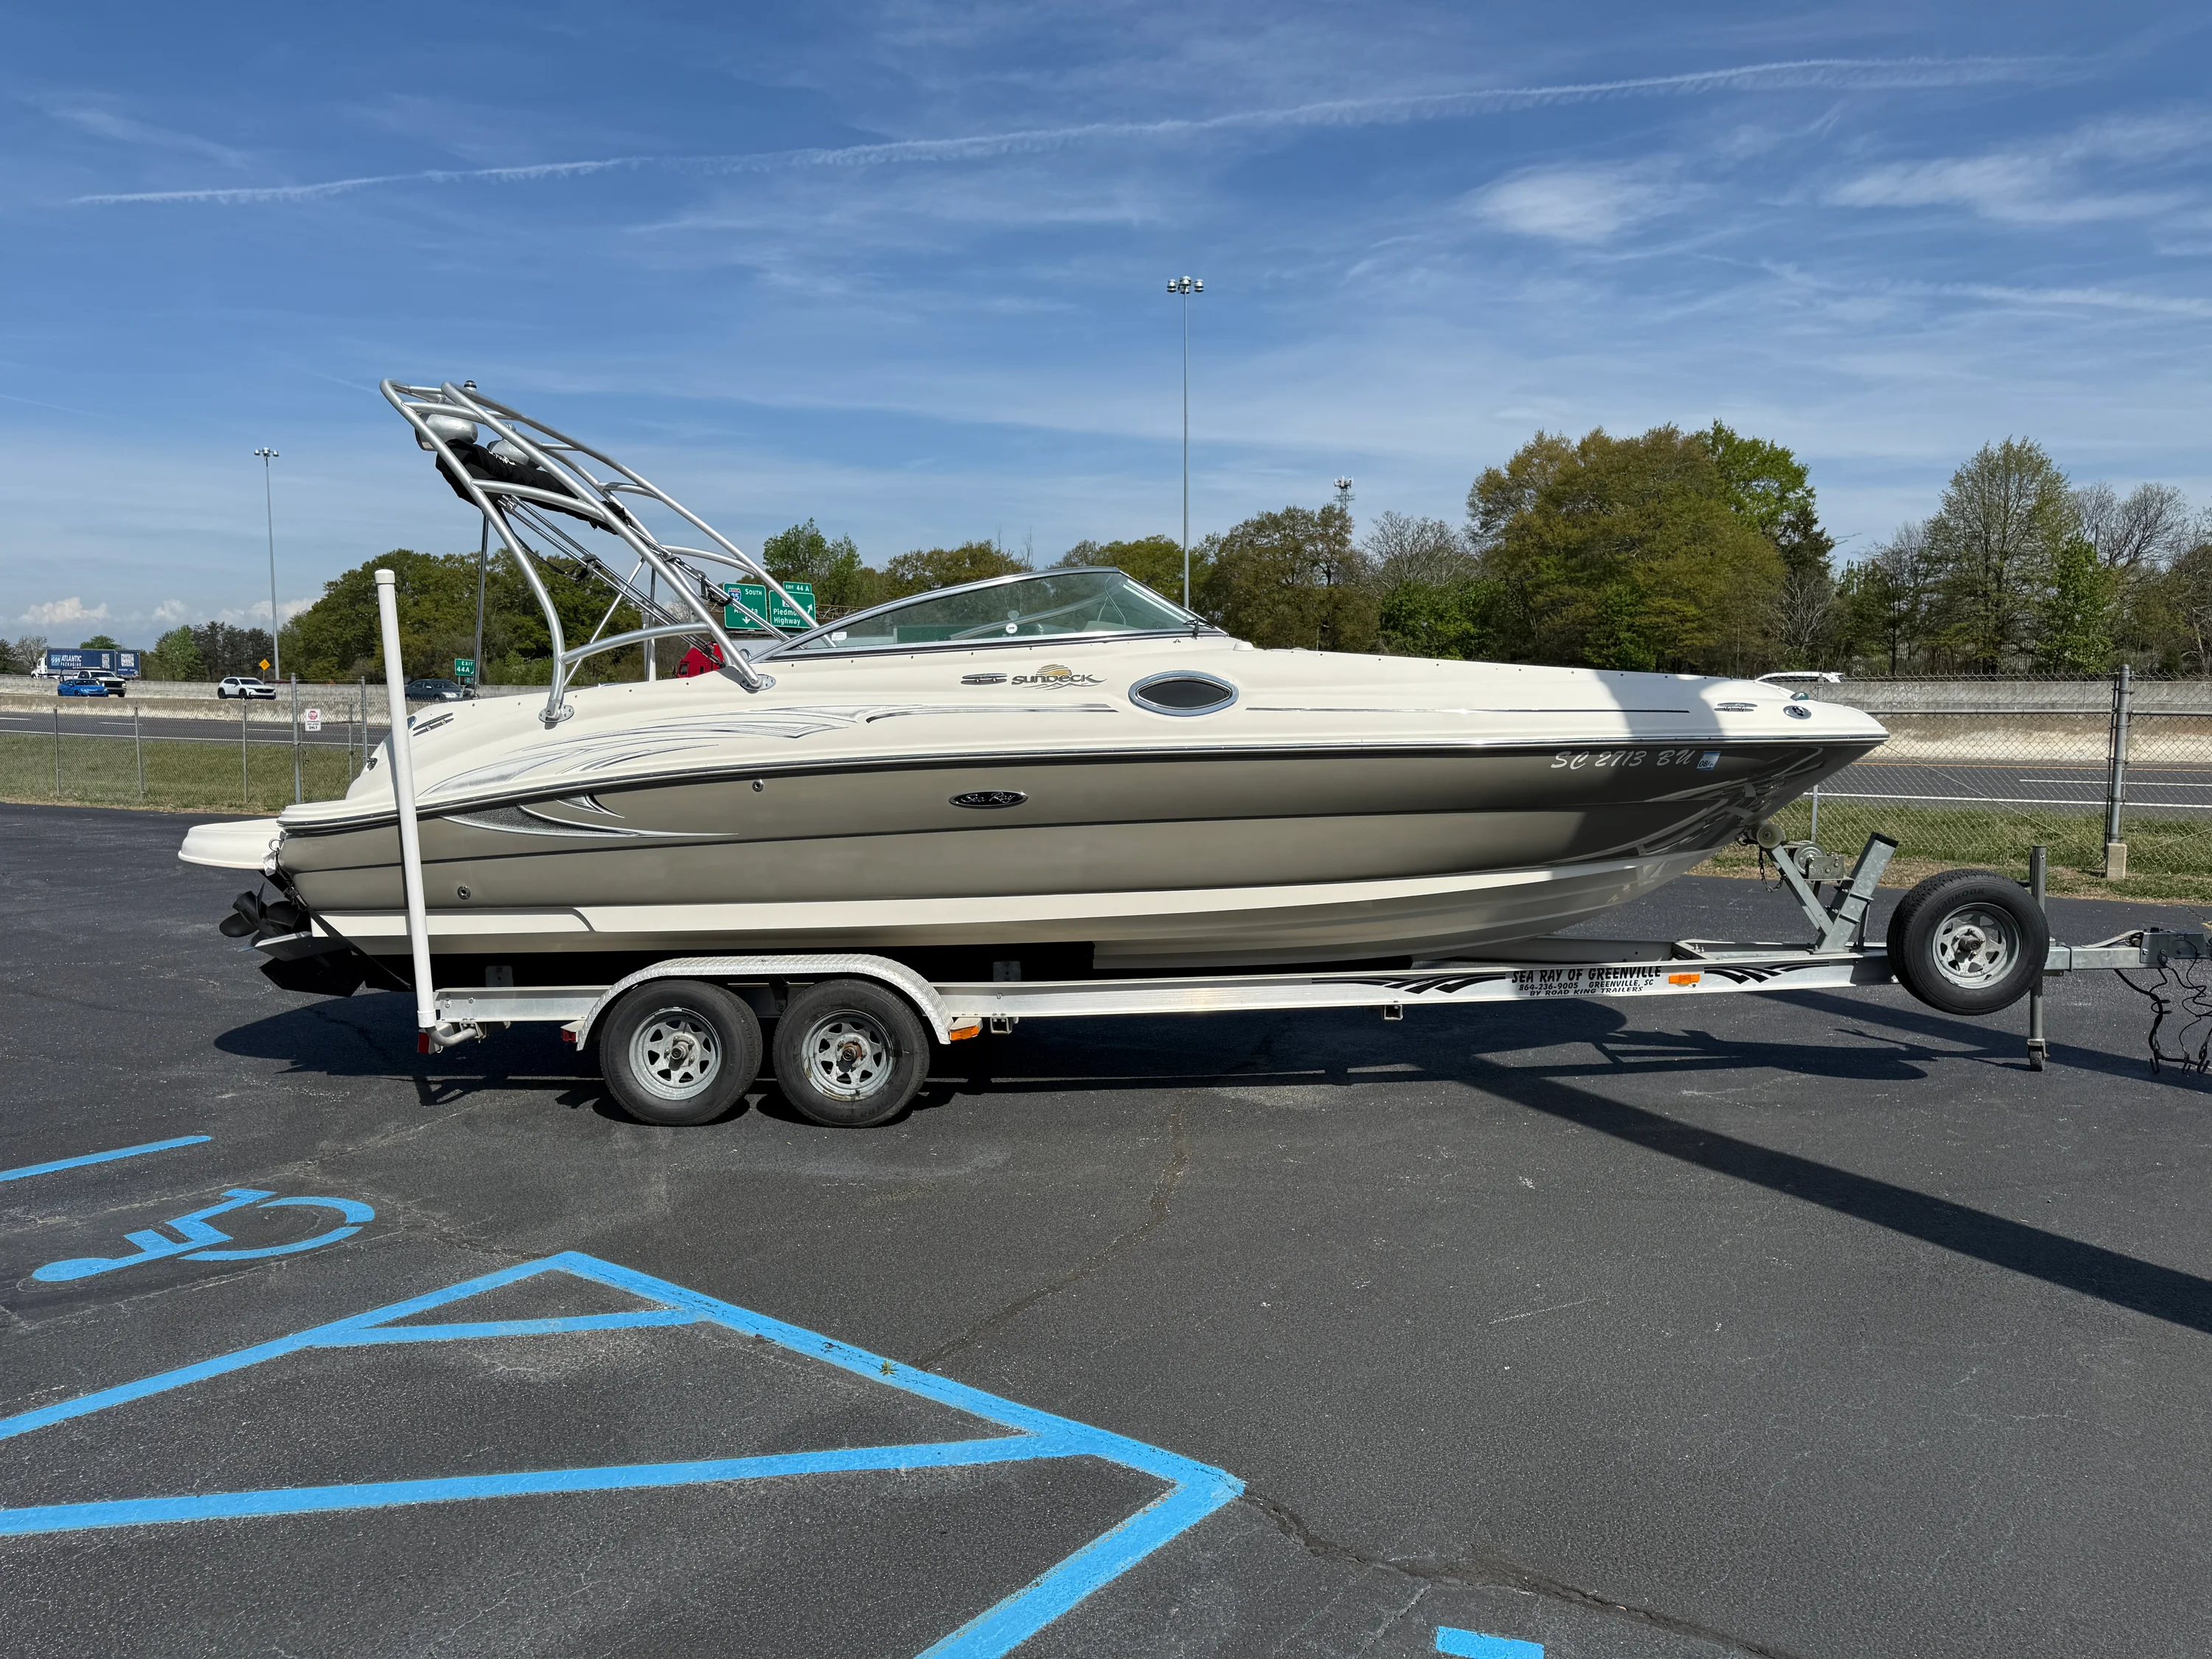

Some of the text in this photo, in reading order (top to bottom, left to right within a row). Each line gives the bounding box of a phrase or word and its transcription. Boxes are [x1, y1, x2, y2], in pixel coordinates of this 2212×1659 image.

[773, 608, 799, 616] Piedmo
[774, 617, 801, 626] Highway
[1551, 749, 1696, 770] SC 2713 BU
[961, 792, 1016, 804] Sea Ray
[1512, 966, 1662, 983] SEA RAY OF GREENVILLE
[1519, 982, 1579, 991] 864-236-9005
[1588, 979, 1641, 988] GREENVILLE,
